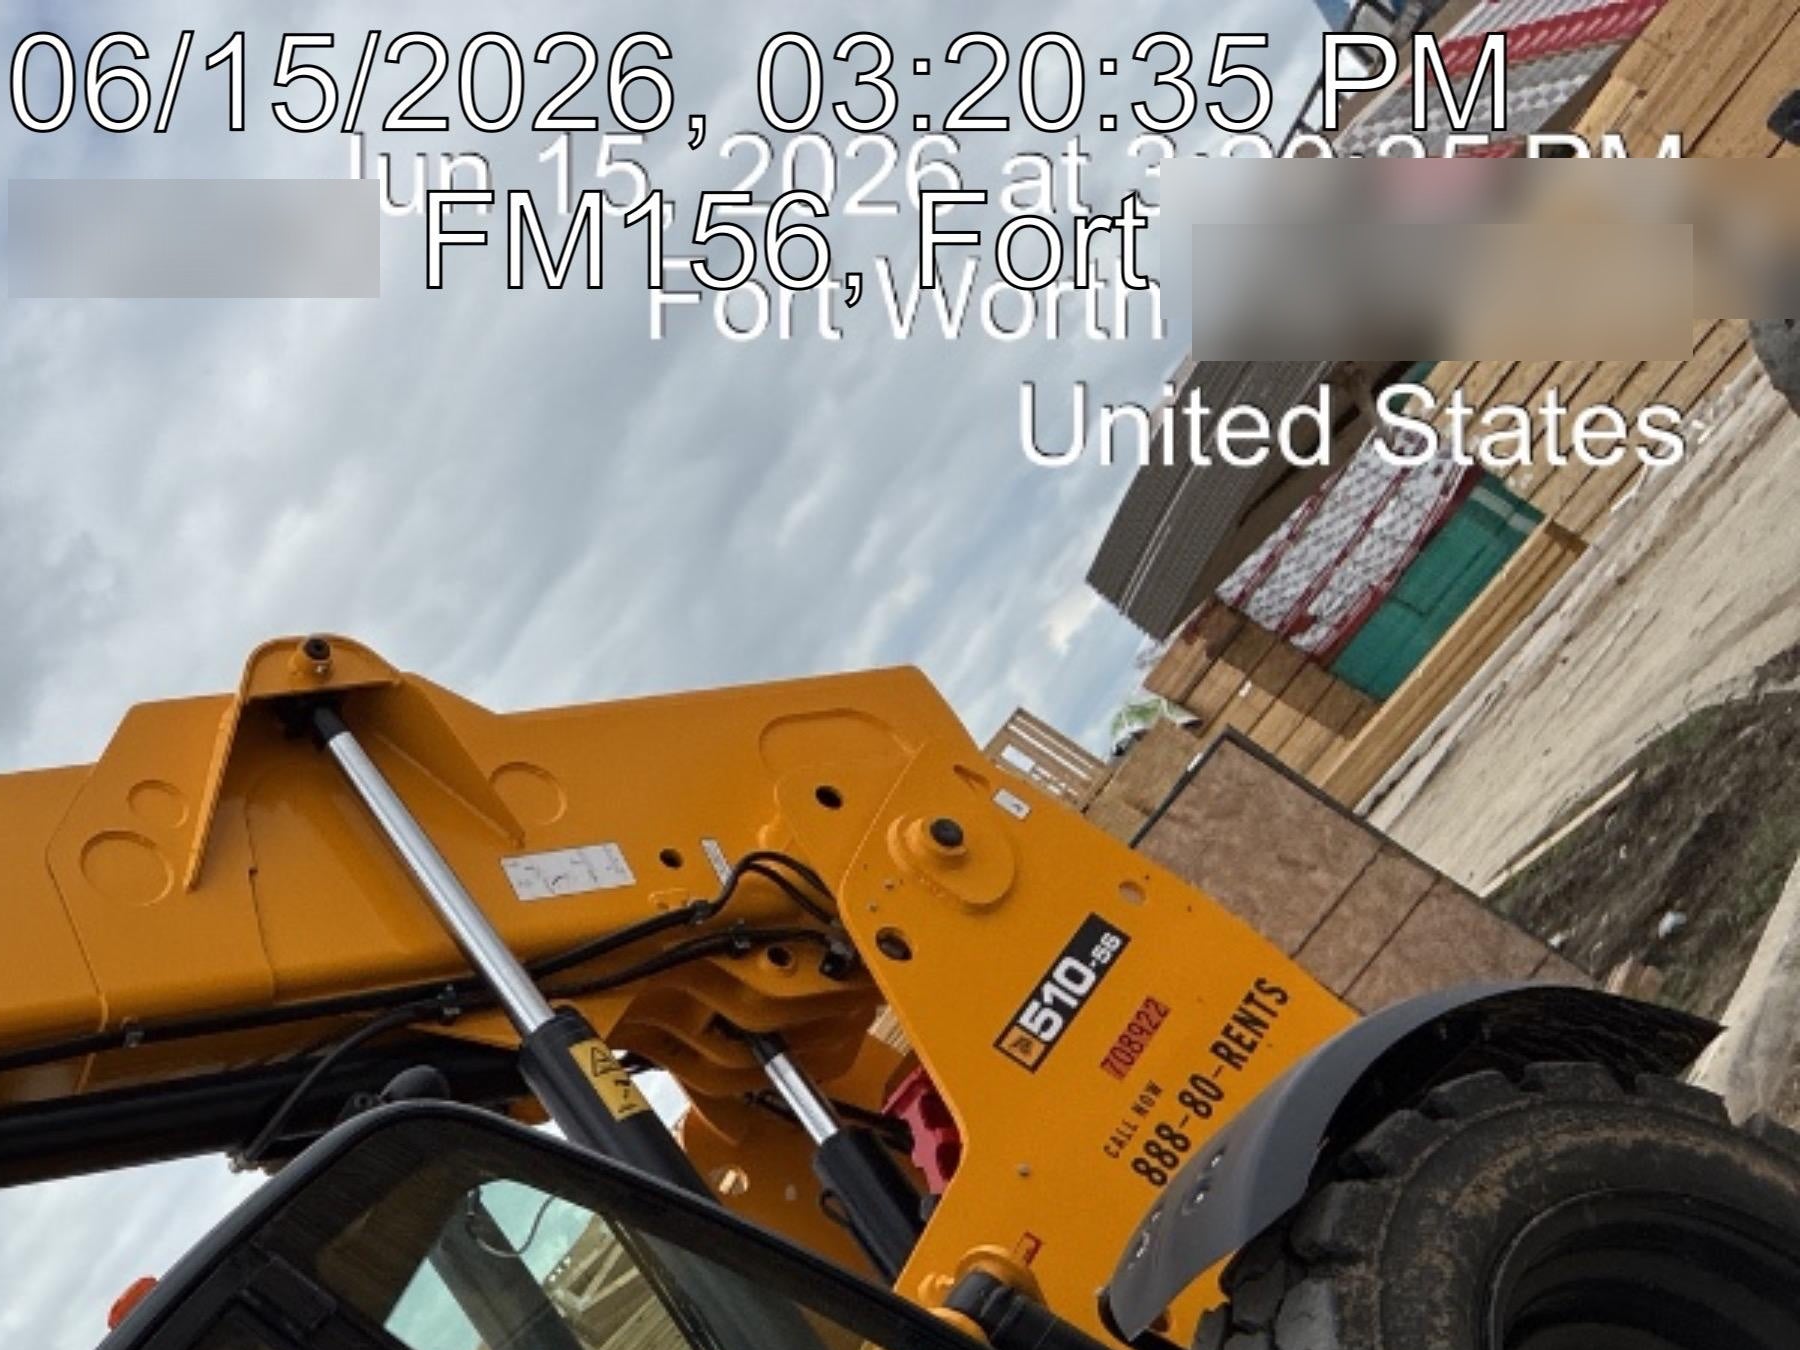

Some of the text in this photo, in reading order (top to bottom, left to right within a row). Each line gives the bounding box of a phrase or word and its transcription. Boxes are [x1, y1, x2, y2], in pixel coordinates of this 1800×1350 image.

[1100, 996, 1171, 1080] 708922
[1104, 1080, 1163, 1160] CALL NOW
[1131, 977, 1290, 1188] 888-80-RENTS
